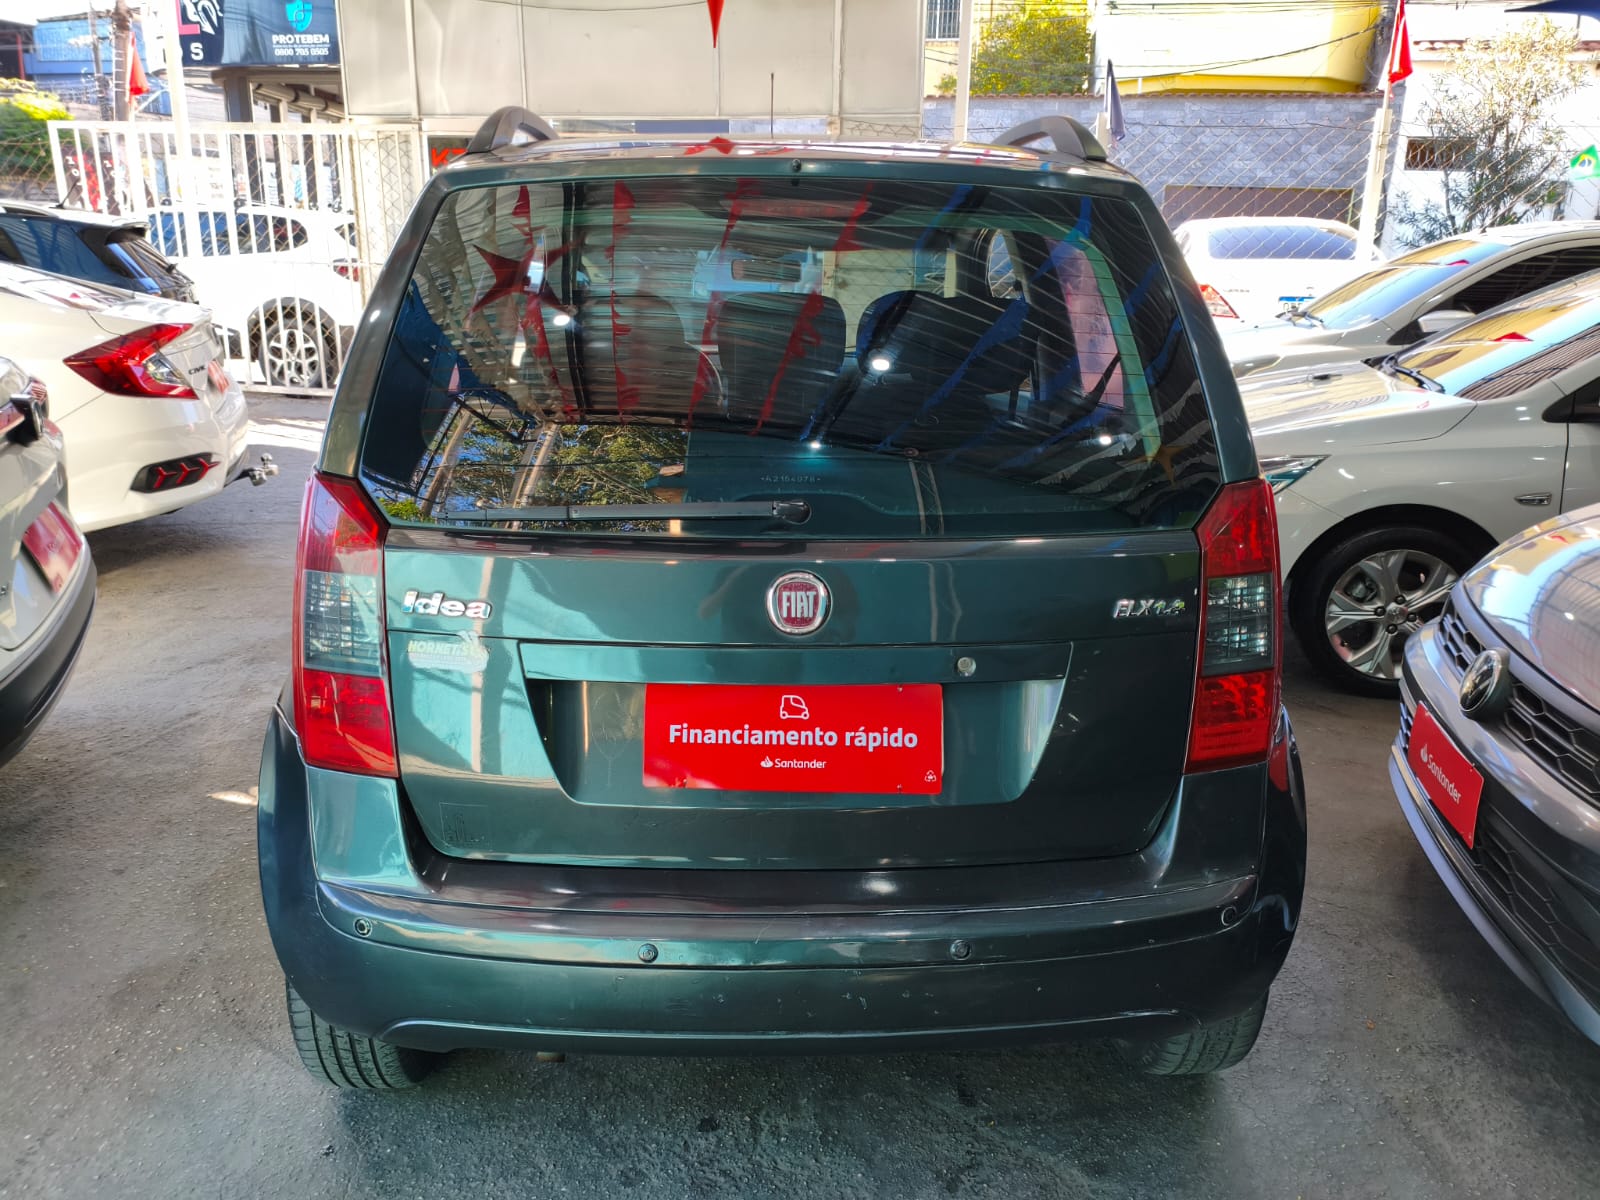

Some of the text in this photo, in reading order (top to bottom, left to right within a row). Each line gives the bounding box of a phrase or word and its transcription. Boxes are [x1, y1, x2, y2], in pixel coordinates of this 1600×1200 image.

[272, 34, 330, 44] PROTEBEM
[274, 48, 294, 56] 0800
[782, 591, 817, 618] FIAT
[669, 723, 918, 752] Financiamento rápido
[774, 758, 827, 769] Santander
[1427, 752, 1462, 805] Santander
